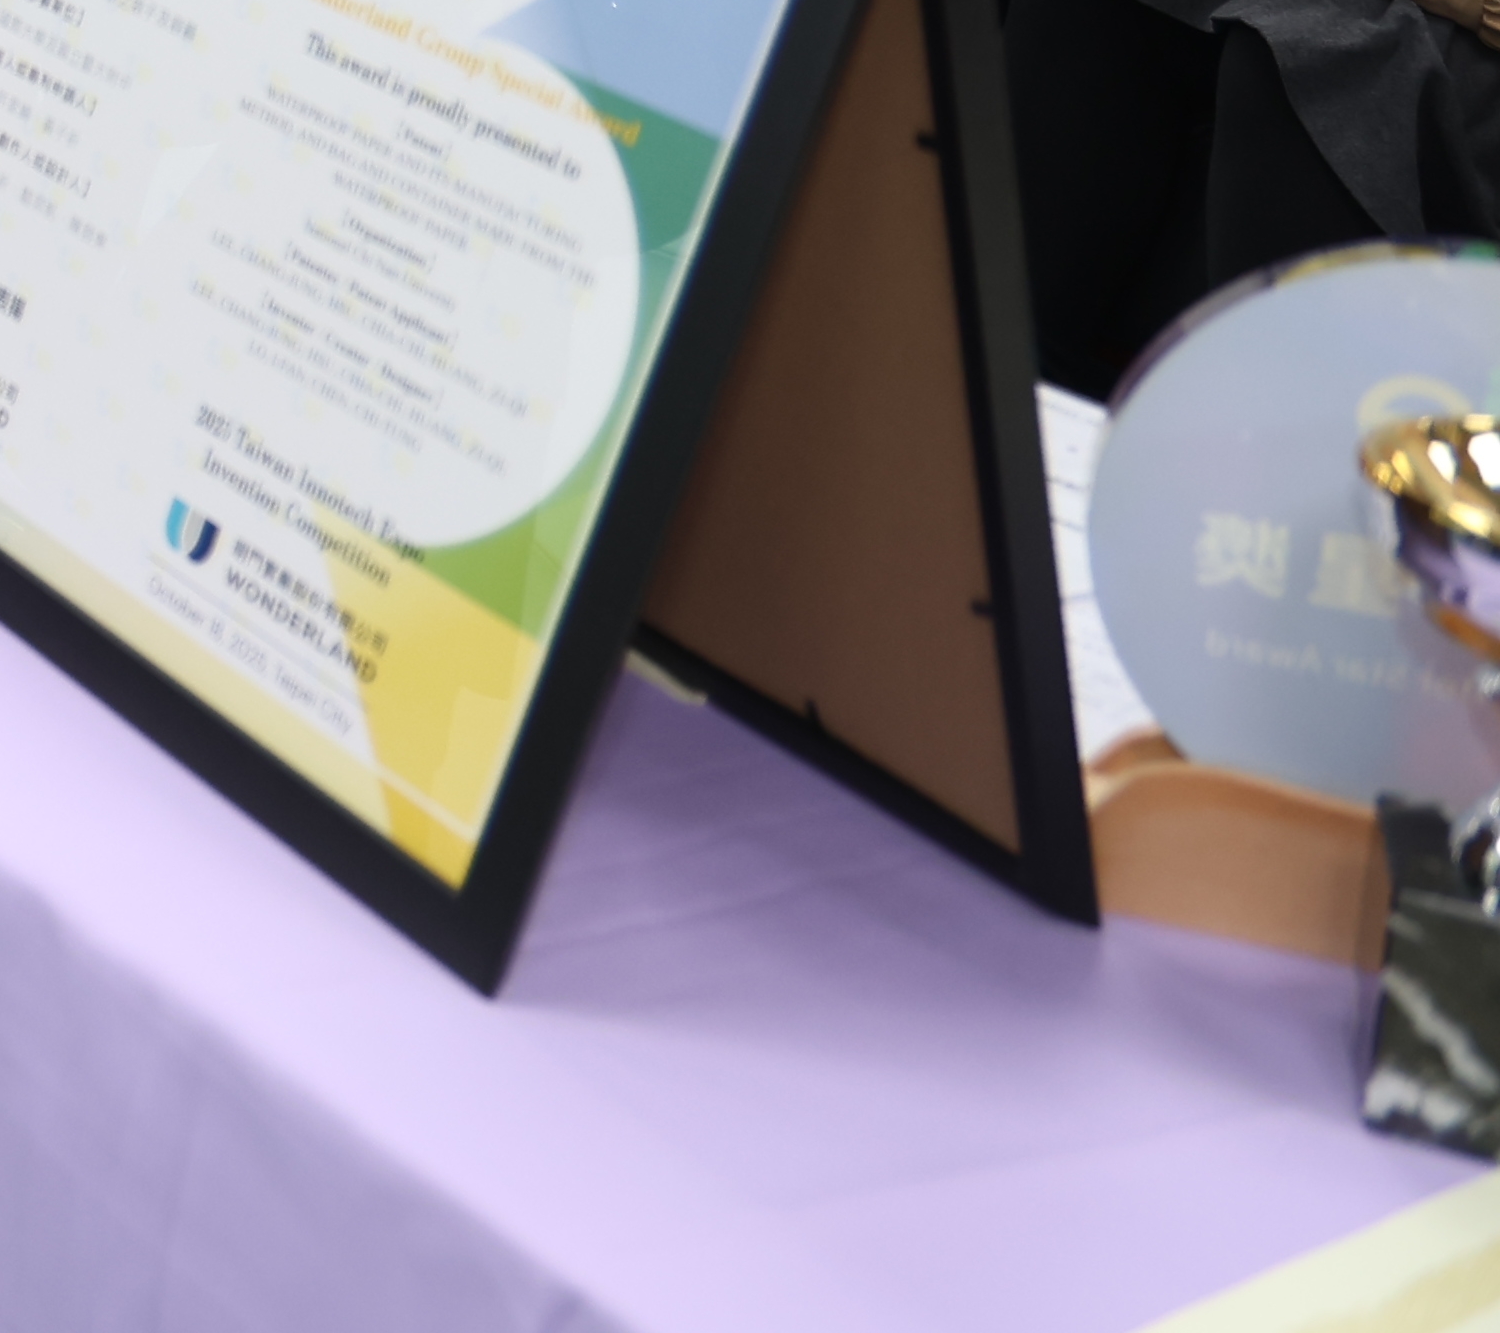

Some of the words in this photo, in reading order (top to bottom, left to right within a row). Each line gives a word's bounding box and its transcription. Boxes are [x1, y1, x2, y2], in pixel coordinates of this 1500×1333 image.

[302, 28, 342, 67] This
[337, 47, 391, 91] award
[390, 72, 410, 100] is
[405, 79, 475, 134] proudly
[472, 110, 564, 177] presented
[561, 153, 585, 184] to
[412, 24, 488, 81] Group
[487, 57, 566, 117] Special
[568, 93, 644, 147] Award
[194, 401, 235, 444] 2025
[232, 425, 299, 485] Taiwan
[297, 466, 379, 536] Innotech
[375, 517, 429, 572] Expo
[202, 446, 284, 516] Invention
[281, 499, 395, 595] Competition
[146, 573, 207, 630] October
[272, 665, 319, 715] Taipei
[317, 697, 354, 739] City
[222, 563, 380, 690] WONDERLAND
